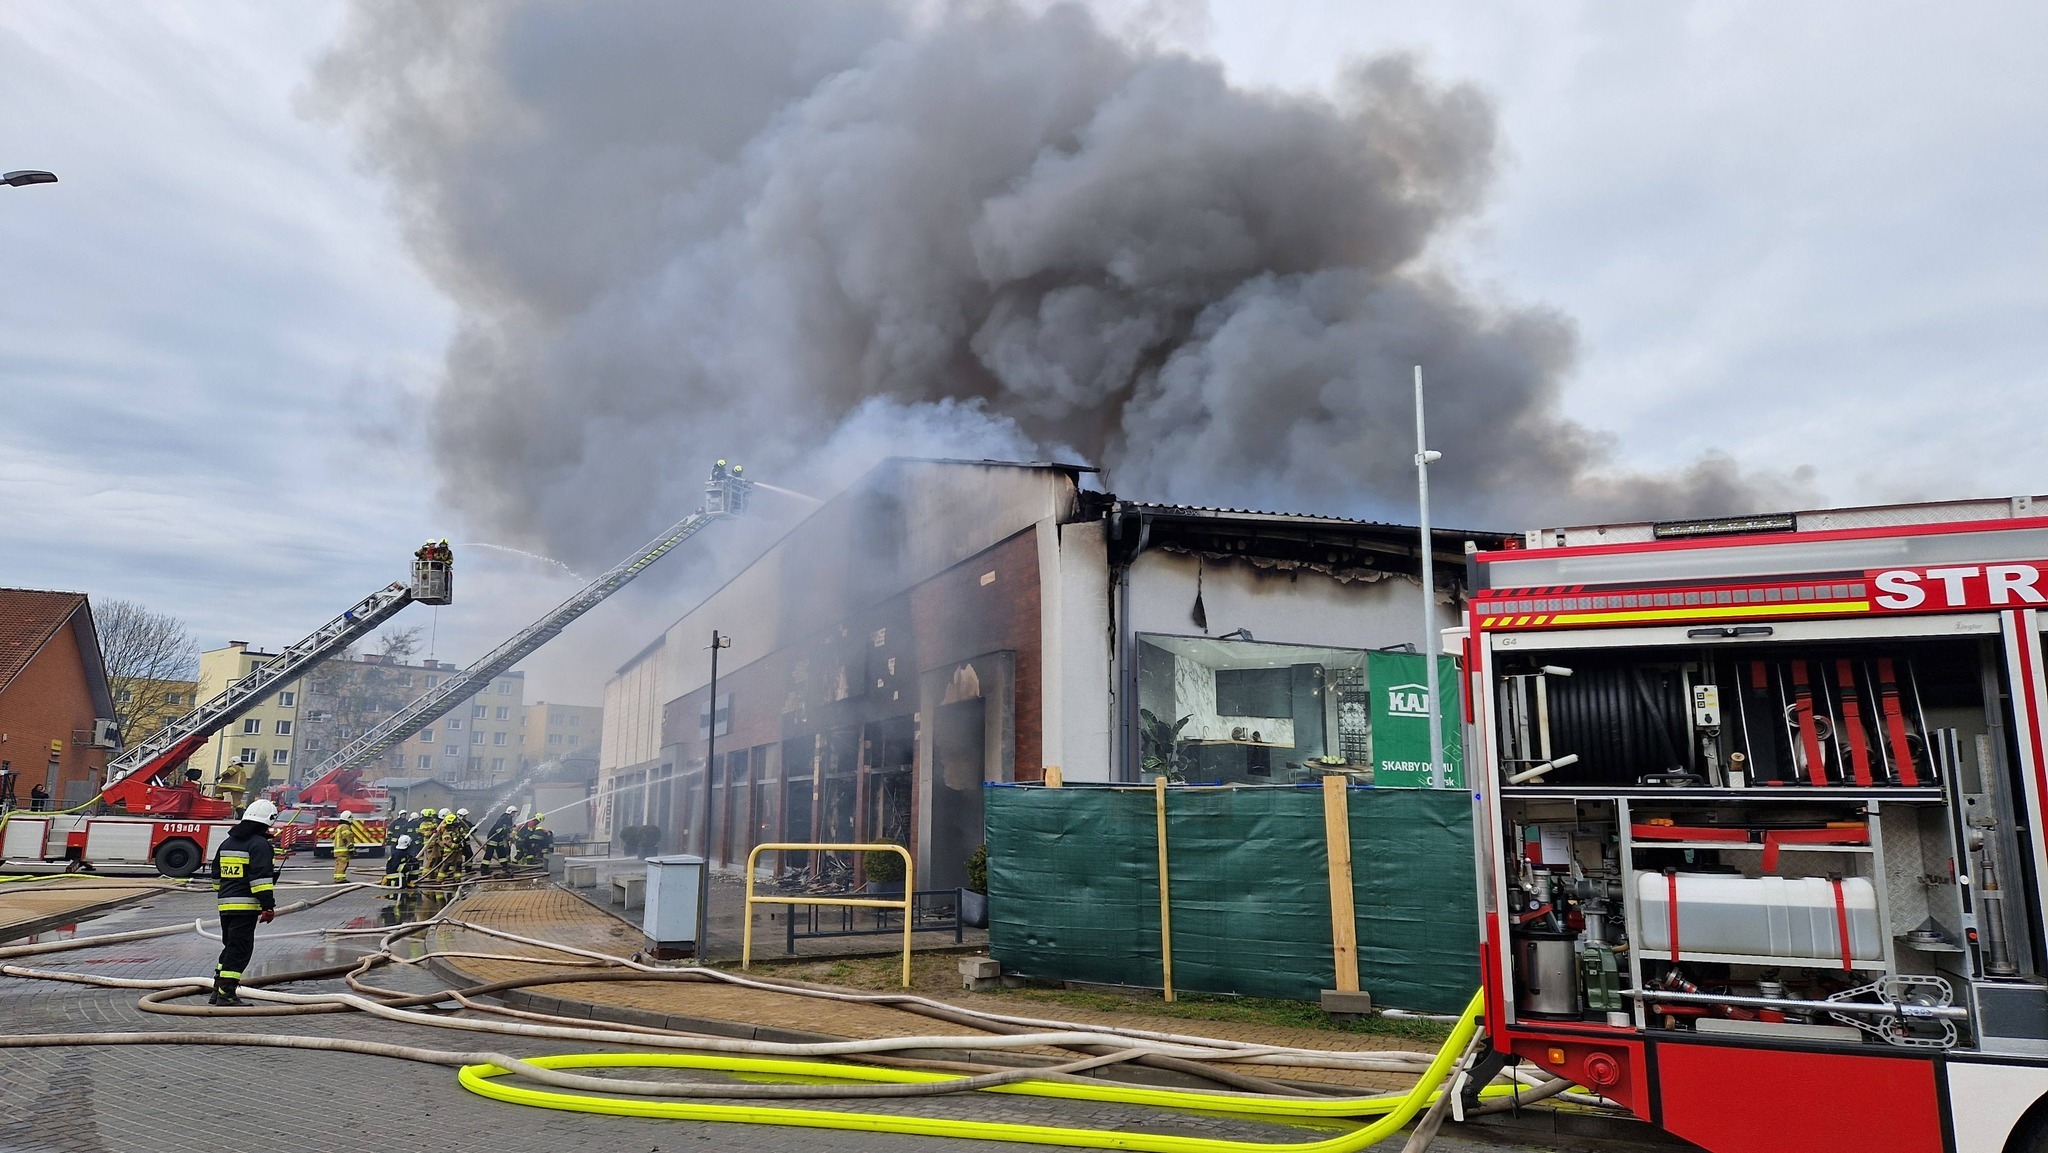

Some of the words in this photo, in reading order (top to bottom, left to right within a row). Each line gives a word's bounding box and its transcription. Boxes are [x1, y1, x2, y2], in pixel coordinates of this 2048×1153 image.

[1875, 564, 2047, 610] STR
[1502, 637, 1517, 646] G4
[1382, 760, 1420, 772] SKARBY
